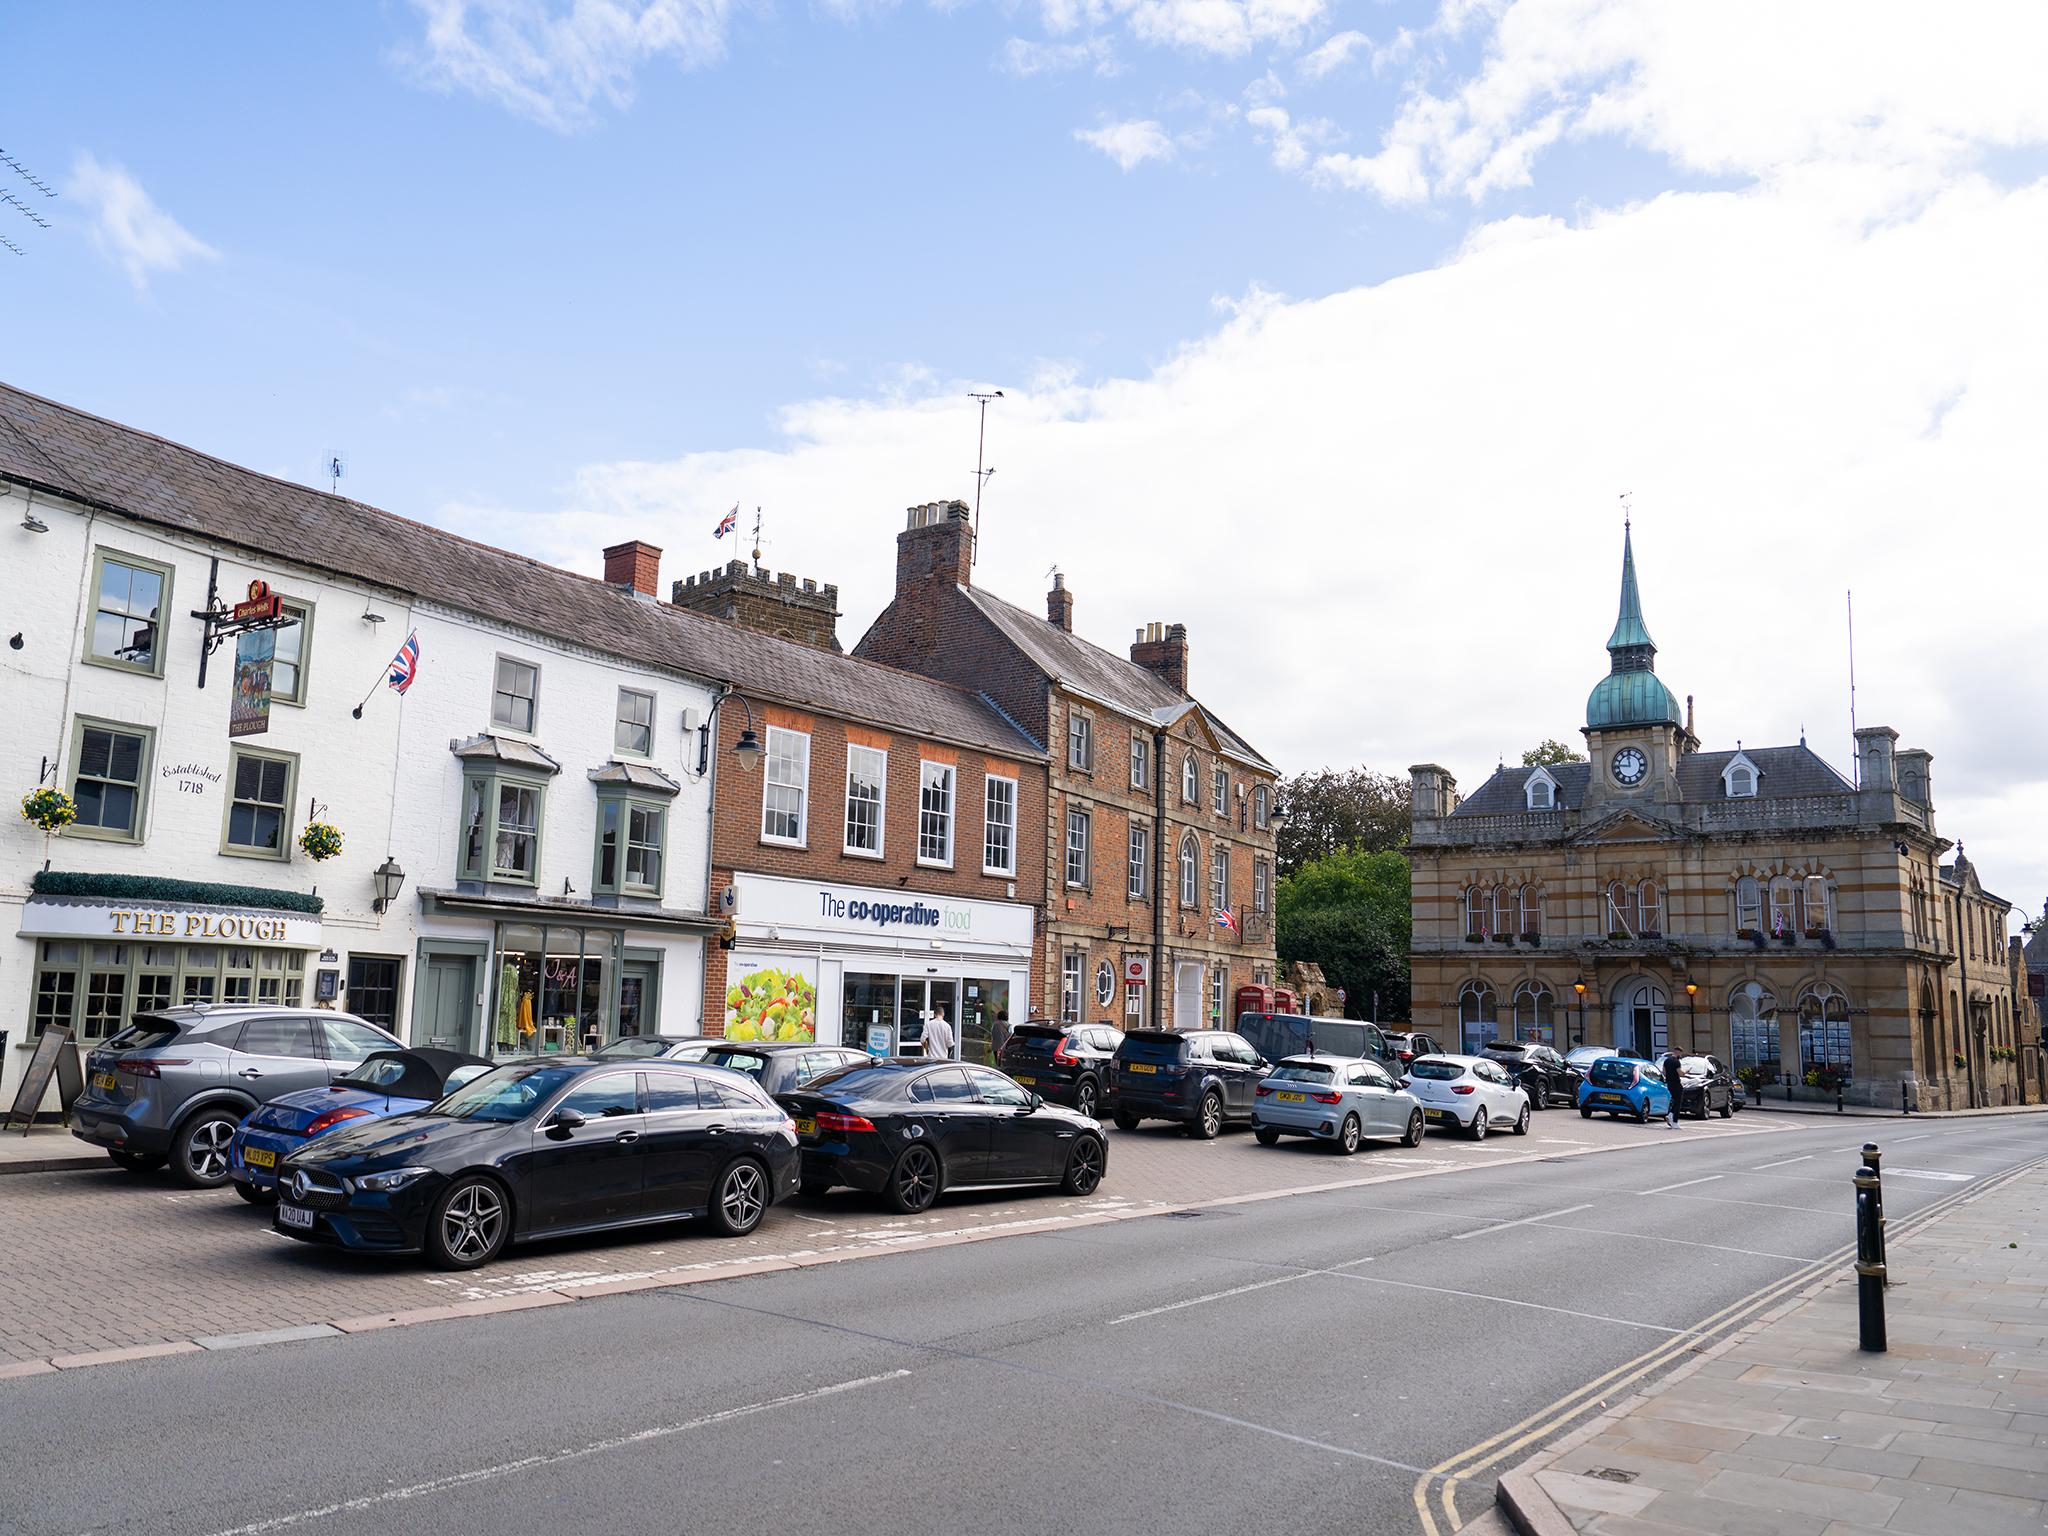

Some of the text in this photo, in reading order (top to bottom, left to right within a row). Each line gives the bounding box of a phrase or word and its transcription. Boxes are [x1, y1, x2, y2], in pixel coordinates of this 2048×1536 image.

[238, 606, 256, 617] Charles
[232, 719, 266, 733] THE PLOUGH
[162, 763, 222, 783] Established
[179, 780, 204, 794] 1718
[819, 892, 845, 918] The
[944, 905, 971, 930] food
[110, 911, 287, 940] THE PLOUGH
[260, 1152, 273, 1165] XPS
[297, 1210, 312, 1225] UAJ
